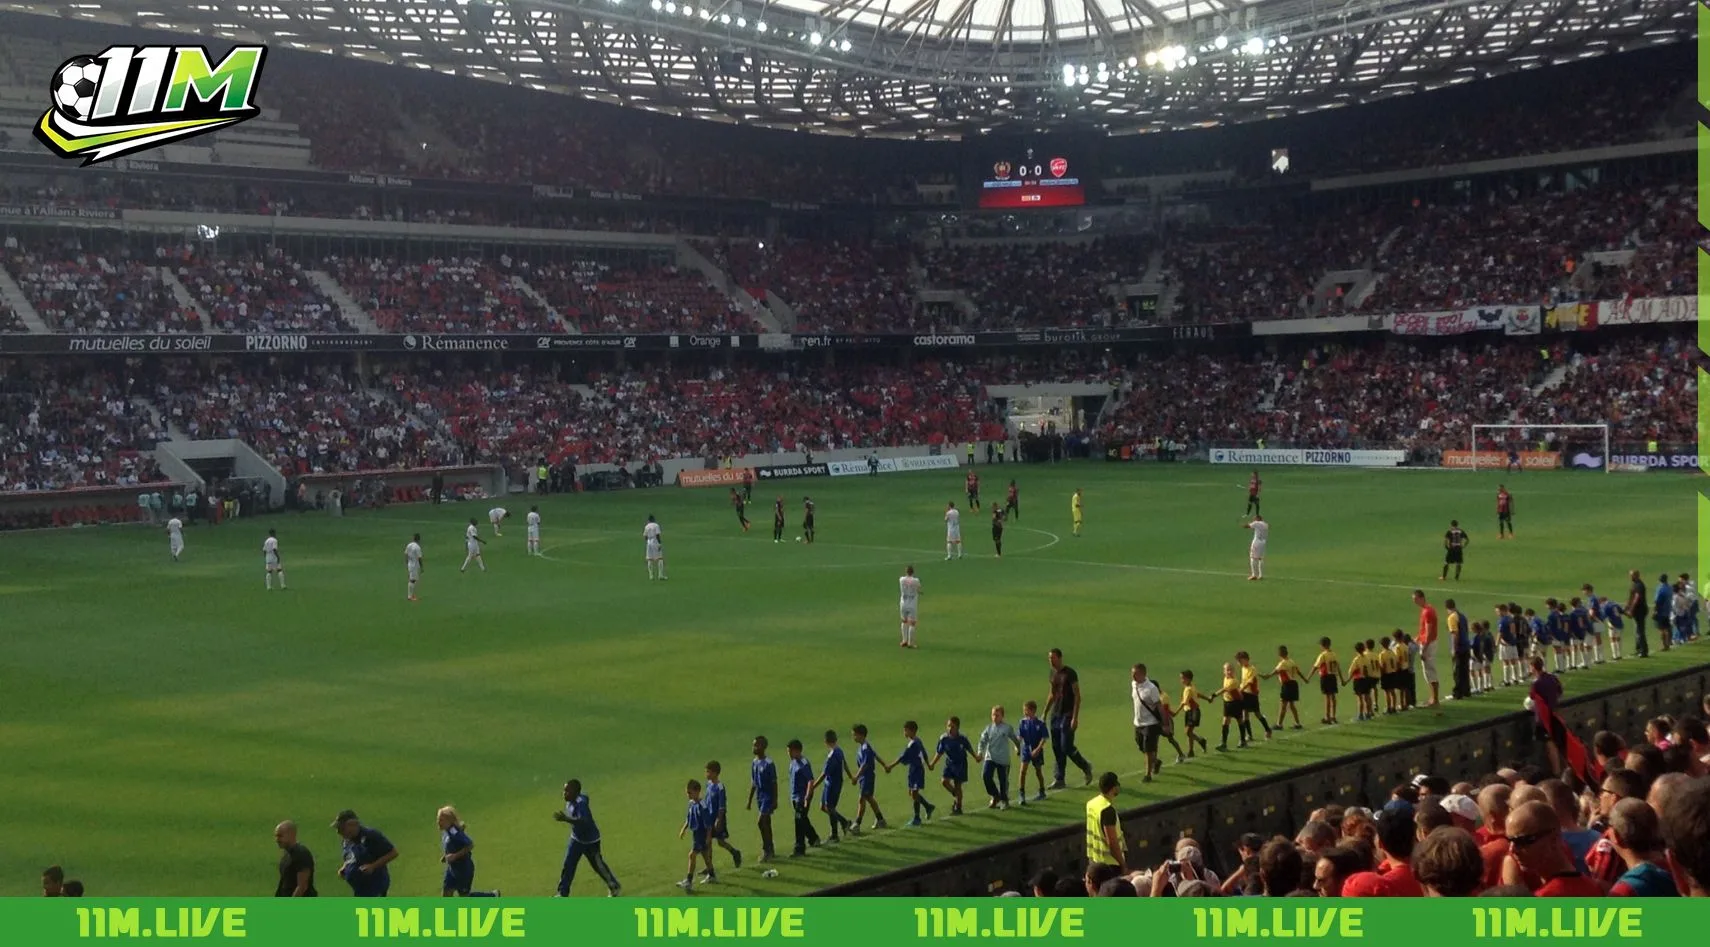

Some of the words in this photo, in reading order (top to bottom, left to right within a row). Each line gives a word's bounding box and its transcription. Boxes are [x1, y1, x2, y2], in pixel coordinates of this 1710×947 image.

[1019, 165, 1027, 176] 0
[1034, 165, 1042, 176] 0
[78, 207, 116, 219] Riviera
[69, 336, 145, 350] mutuelles
[149, 336, 171, 350] du
[174, 336, 212, 350] soleil
[246, 335, 308, 351] PIZZORNO
[422, 335, 509, 350] Rémanence
[689, 336, 721, 348] Orange
[914, 334, 975, 347] castorama
[1044, 331, 1085, 342] burotik
[1228, 450, 1299, 463] Rémanence
[1305, 451, 1351, 464] PIZZORNO
[1525, 454, 1556, 466] soleil
[682, 473, 722, 484] mutuelles
[722, 471, 734, 481] du
[774, 467, 801, 478] BURRDA
[803, 465, 826, 476] SPORT
